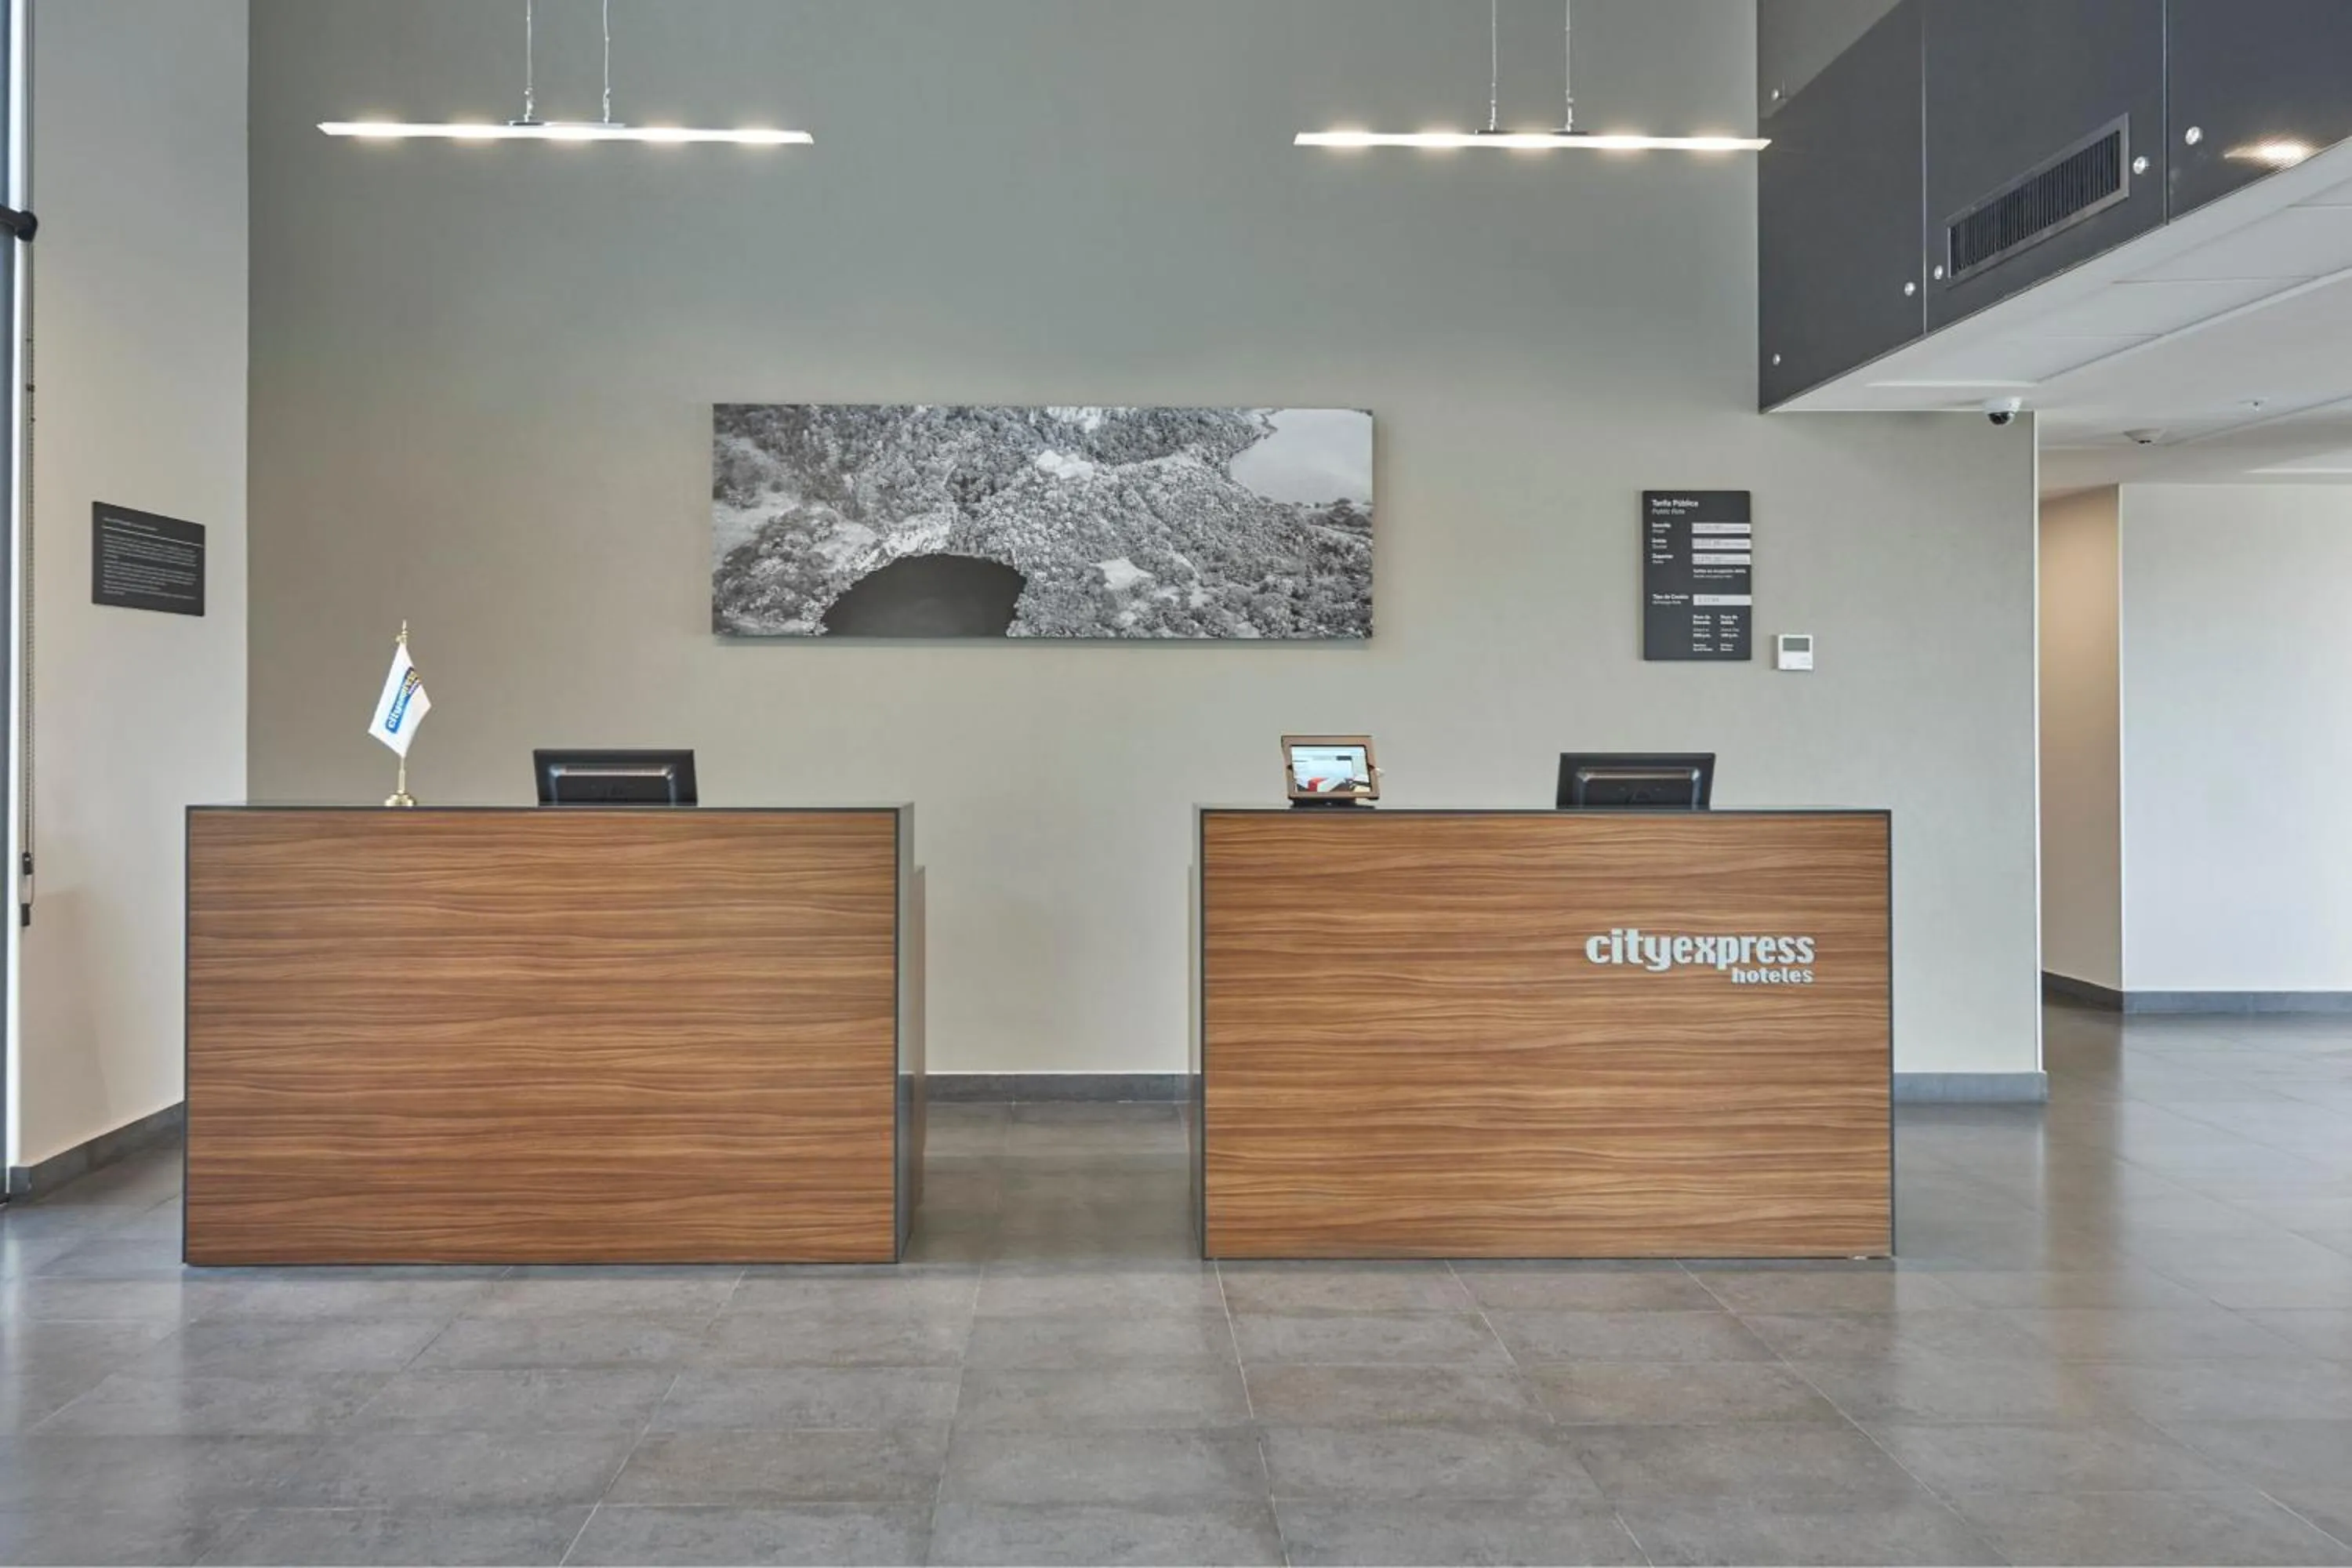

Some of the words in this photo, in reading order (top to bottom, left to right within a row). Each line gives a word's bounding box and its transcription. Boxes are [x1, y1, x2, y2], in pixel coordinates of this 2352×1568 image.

[1652, 499, 1671, 507] Tarifa
[1585, 928, 1815, 971] cityexpress
[1731, 967, 1814, 984] hoteles
